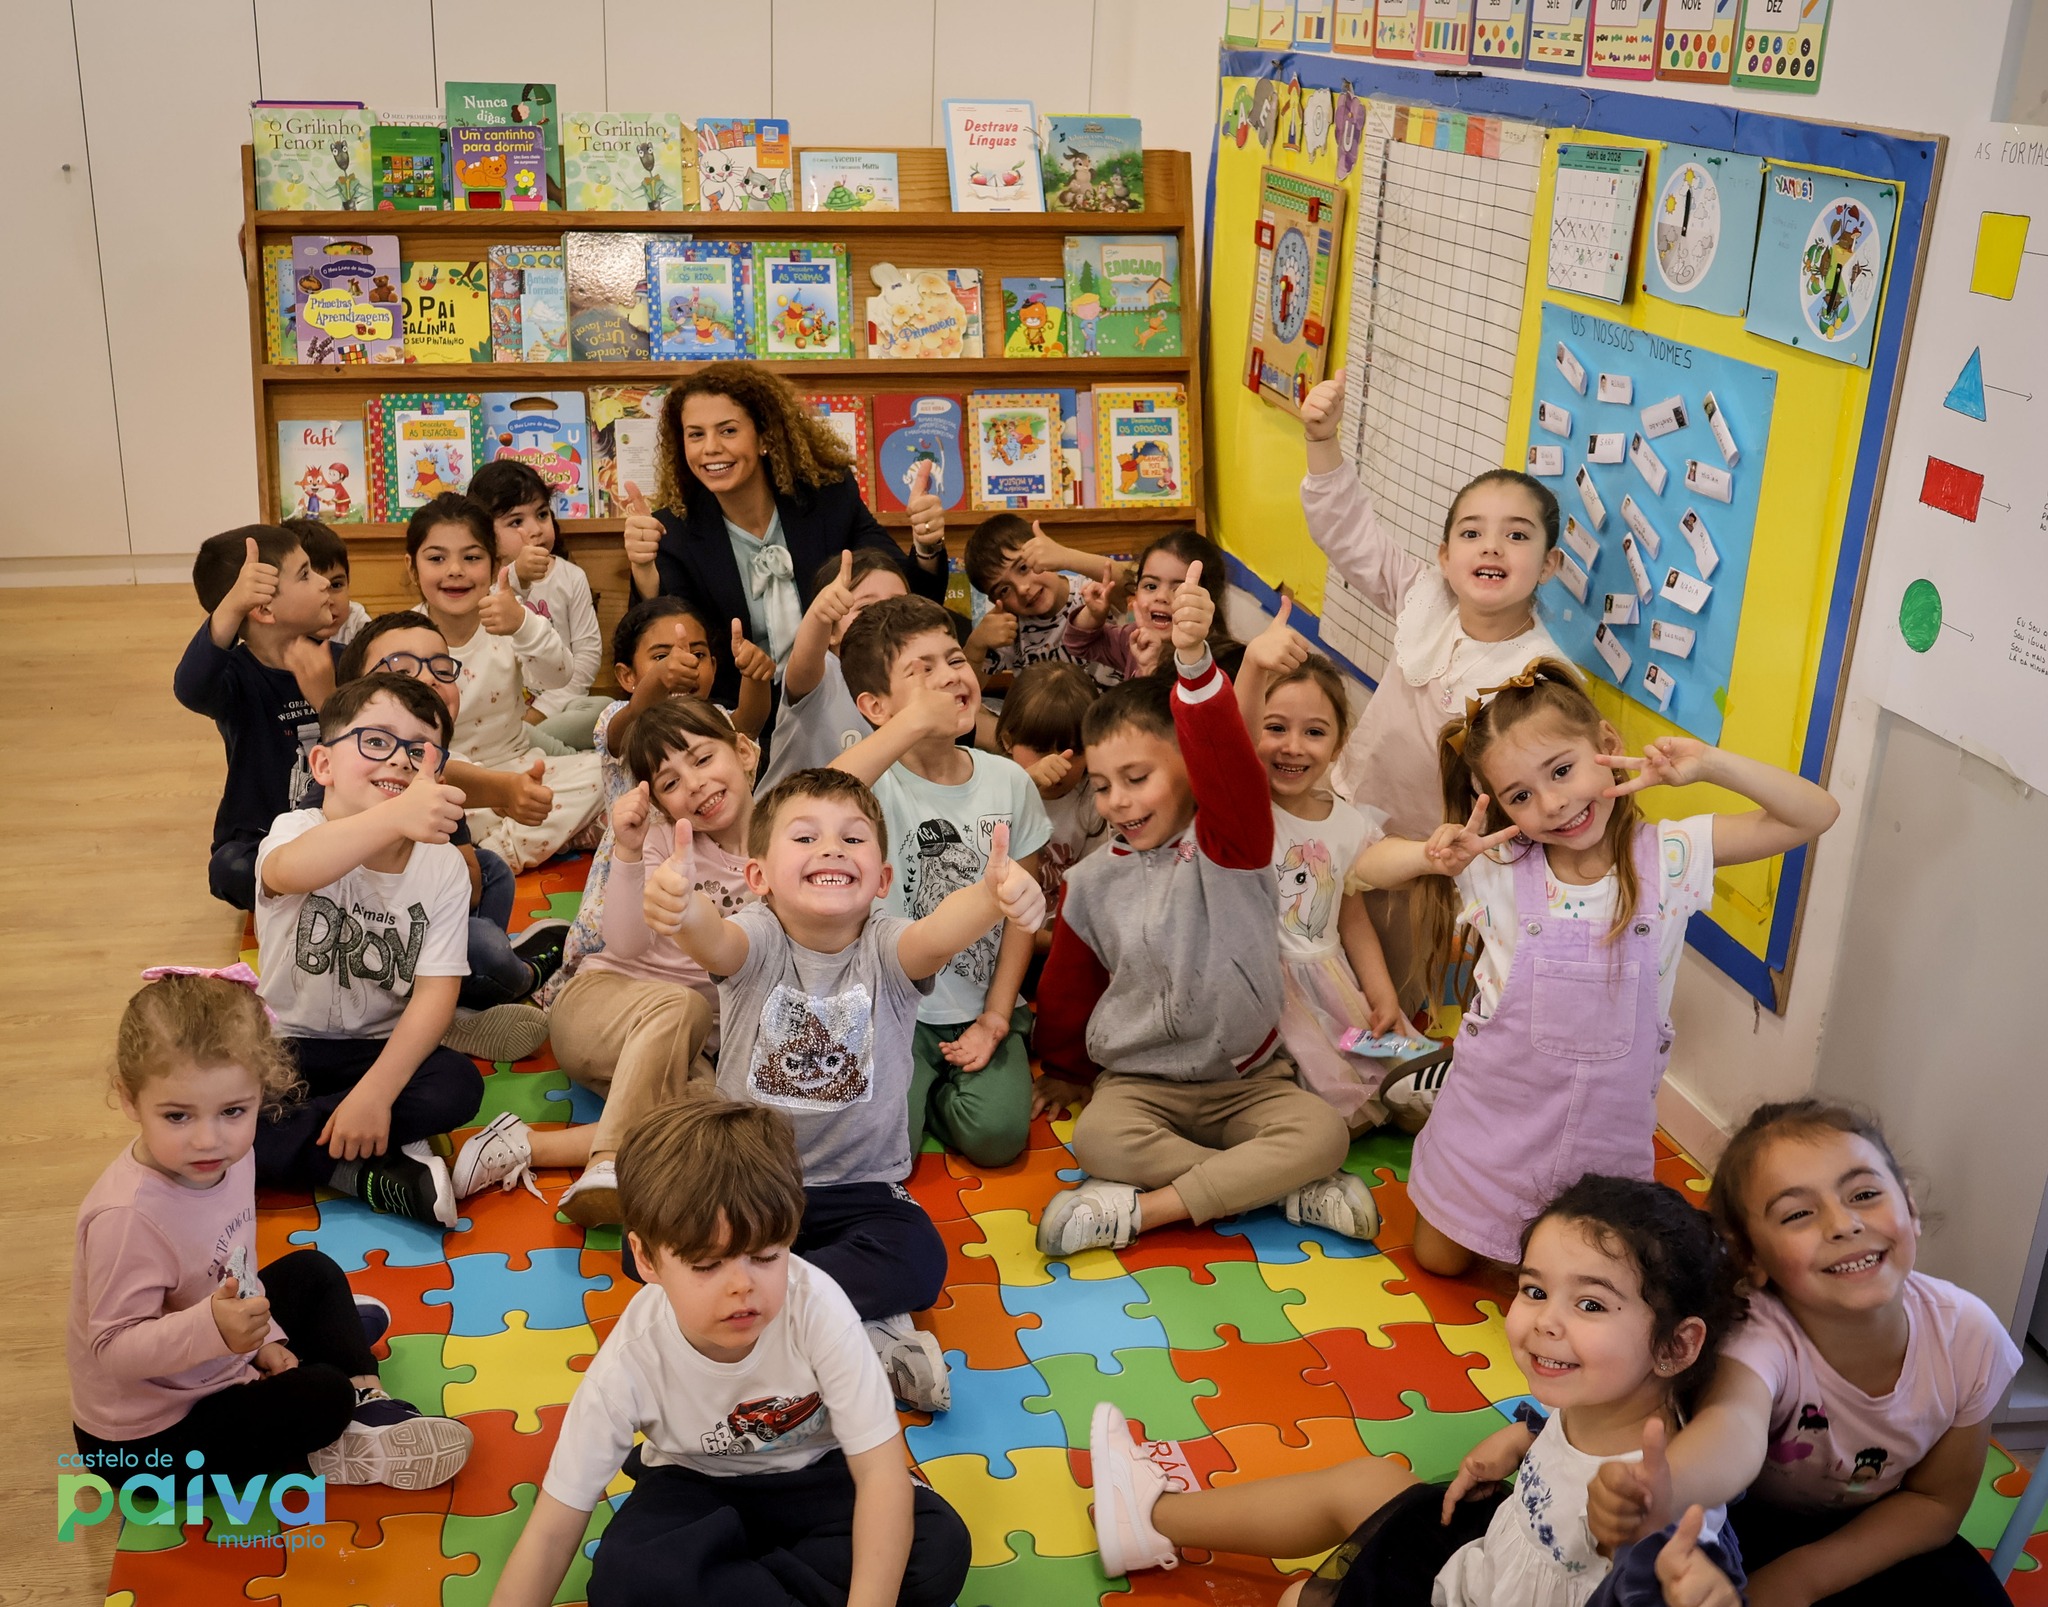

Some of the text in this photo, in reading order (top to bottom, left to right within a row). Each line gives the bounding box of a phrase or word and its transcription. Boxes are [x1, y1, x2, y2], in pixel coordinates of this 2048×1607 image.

[1610, 0, 1627, 10] OITO
[1681, 0, 1702, 11] NOVE
[1766, 0, 1782, 13] DEZ
[463, 96, 508, 109] Nunca
[383, 112, 391, 120] O
[477, 110, 507, 125] digas
[1238, 102, 1246, 130] A
[1259, 98, 1271, 127] E
[270, 120, 282, 132] O
[286, 118, 362, 135] Grilinho
[579, 120, 667, 137] O Grilinho
[964, 119, 1018, 132] Destrava
[269, 133, 325, 150] Tenor
[460, 130, 535, 141] Um cantinho
[968, 133, 1017, 150] Línguas
[1343, 120, 1355, 152] U
[463, 141, 534, 154] para dormir
[578, 136, 631, 152] Tenor
[1586, 150, 1599, 160] Abril
[1974, 142, 1992, 160] AS
[763, 157, 784, 165] Rimas
[1104, 259, 1162, 278] EDUCADO
[678, 273, 713, 281] OS RIOS
[779, 272, 824, 282] AS FORMAS
[311, 297, 352, 309] Primeiras
[315, 308, 390, 326] Aprendizagens
[604, 318, 620, 328] por
[899, 317, 956, 340] Primavera
[411, 337, 425, 345] SEU
[1571, 314, 1692, 369] OS NOSSOS NOMES
[586, 346, 649, 362] ão Acordes
[409, 428, 458, 438] AS ESTAÇÕES
[485, 426, 497, 440] A
[1119, 425, 1168, 434] OS OPOSTOS
[303, 428, 337, 447] Pafi
[532, 434, 539, 447] 1
[567, 429, 580, 444] U
[559, 497, 569, 512] 2
[2028, 621, 2041, 633] SOU
[2013, 629, 2024, 640] SOU
[2011, 642, 2022, 653] SOU
[288, 700, 310, 709] GREA
[278, 709, 303, 721] WERN
[352, 902, 396, 926] Amals
[208, 1235, 229, 1277] CUTE
[242, 1207, 253, 1223] CL
[701, 1425, 731, 1454] 68
